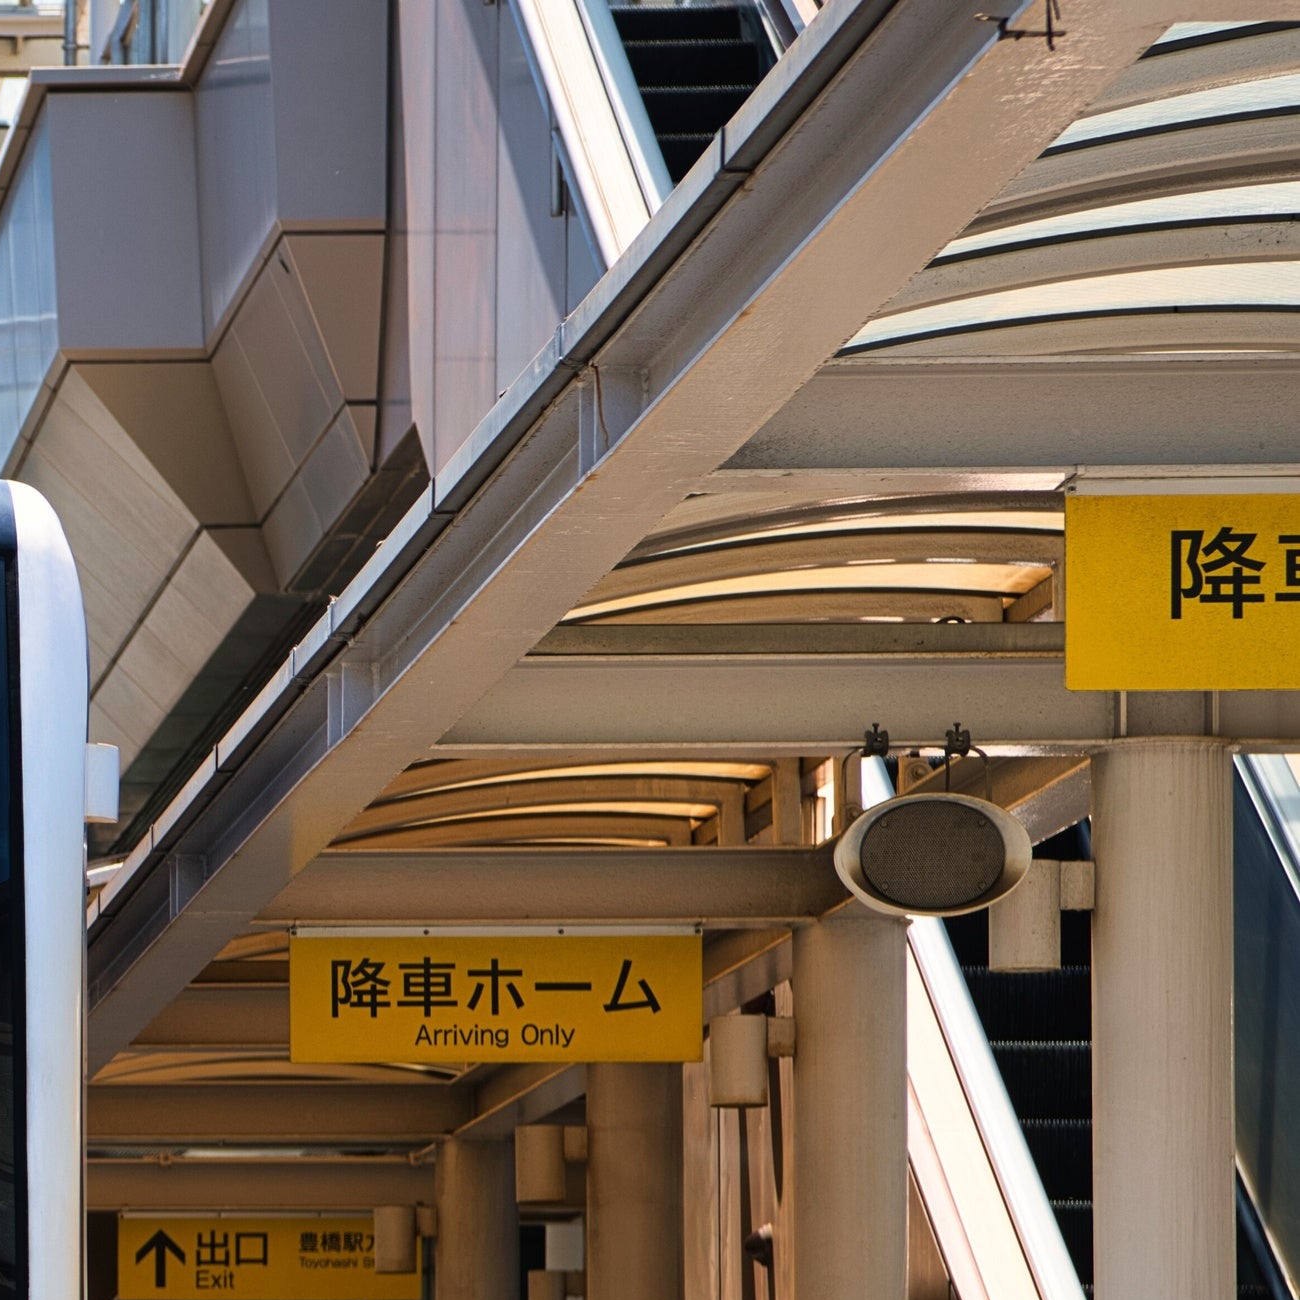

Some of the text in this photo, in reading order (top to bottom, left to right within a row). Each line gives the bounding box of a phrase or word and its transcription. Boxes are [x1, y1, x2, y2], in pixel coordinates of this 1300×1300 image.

[1170, 526, 1300, 620] 降
[330, 956, 662, 1019] 降車ホーム
[415, 1023, 576, 1048] Arriving Only
[195, 1229, 268, 1267] 出口
[299, 1256, 358, 1269] Toyohashi
[195, 1270, 235, 1290] Exit
